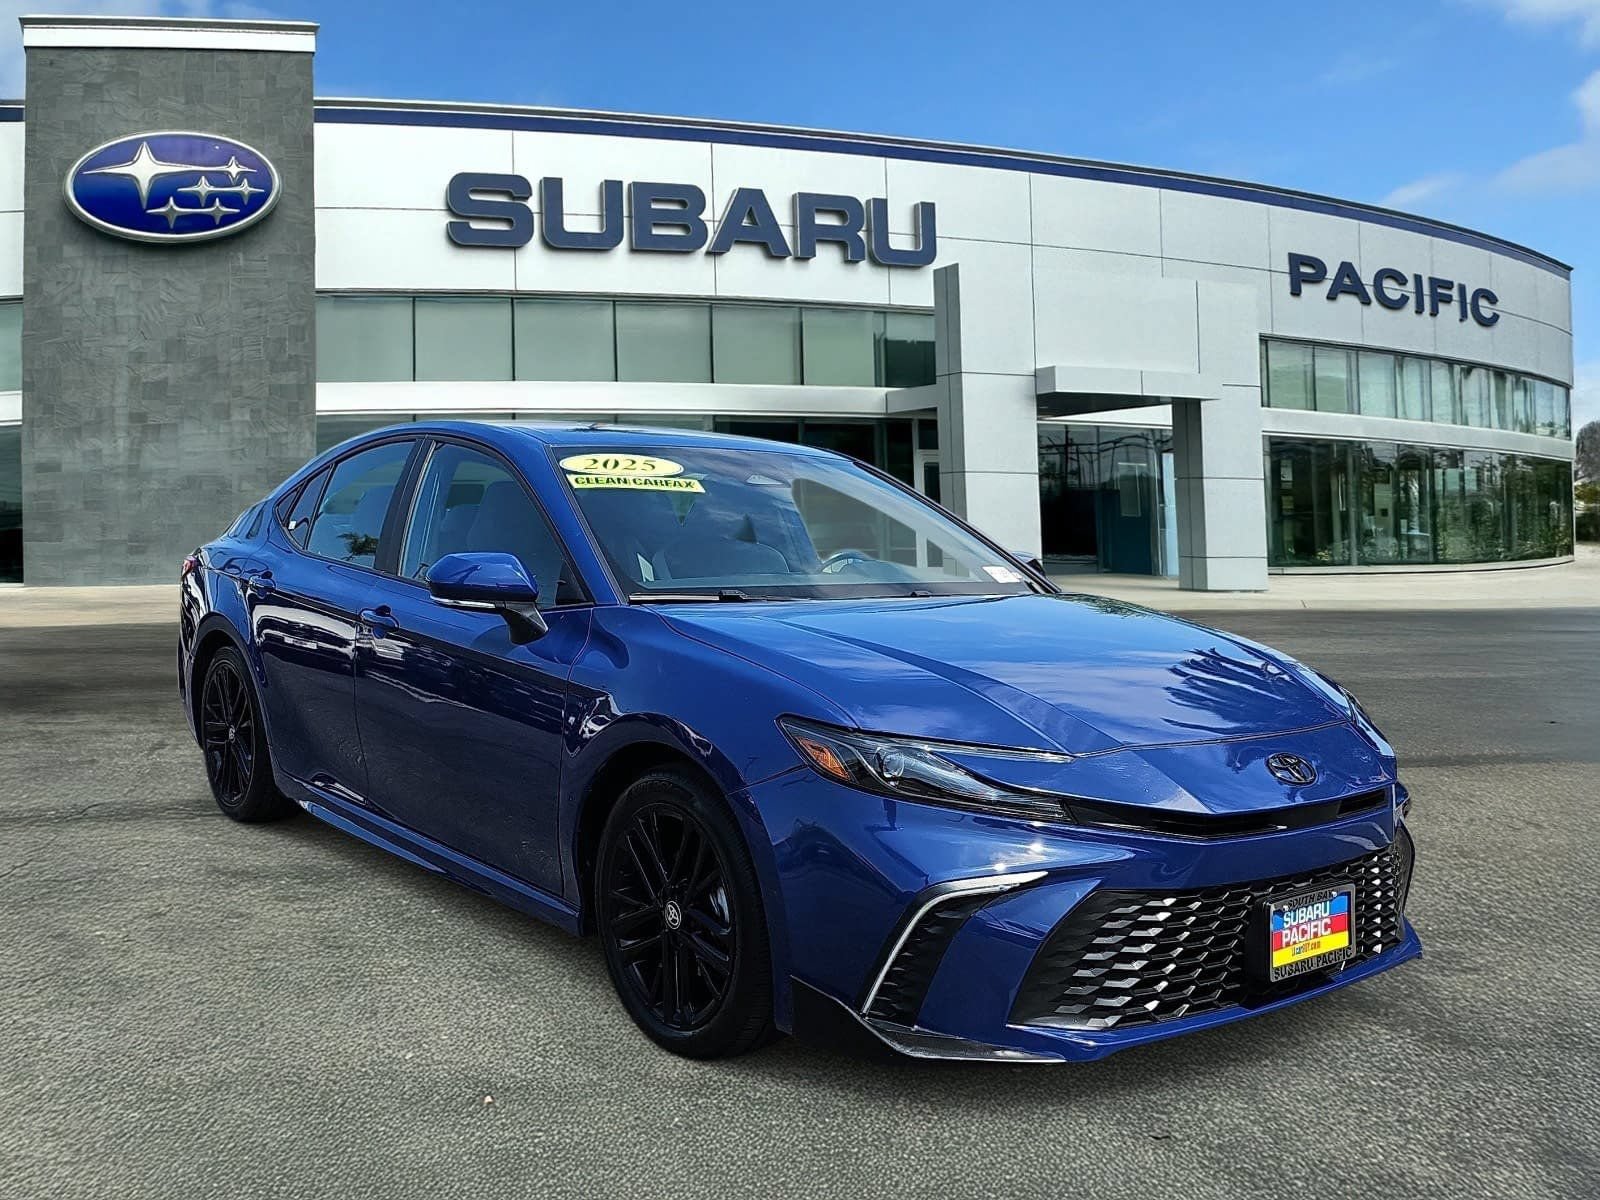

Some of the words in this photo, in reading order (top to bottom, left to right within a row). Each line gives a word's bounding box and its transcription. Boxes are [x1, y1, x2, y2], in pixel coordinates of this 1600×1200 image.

[447, 171, 938, 267] SUBARU
[1288, 252, 1500, 327] PACIFIC
[584, 457, 657, 472] 2025
[574, 476, 627, 486] CLEAN
[632, 477, 696, 489] CARFAX
[1283, 901, 1330, 928] SUBARU
[1282, 918, 1331, 948] PACIFIC
[1274, 960, 1314, 979] SUBARU
[1315, 947, 1352, 967] PACIFIC
